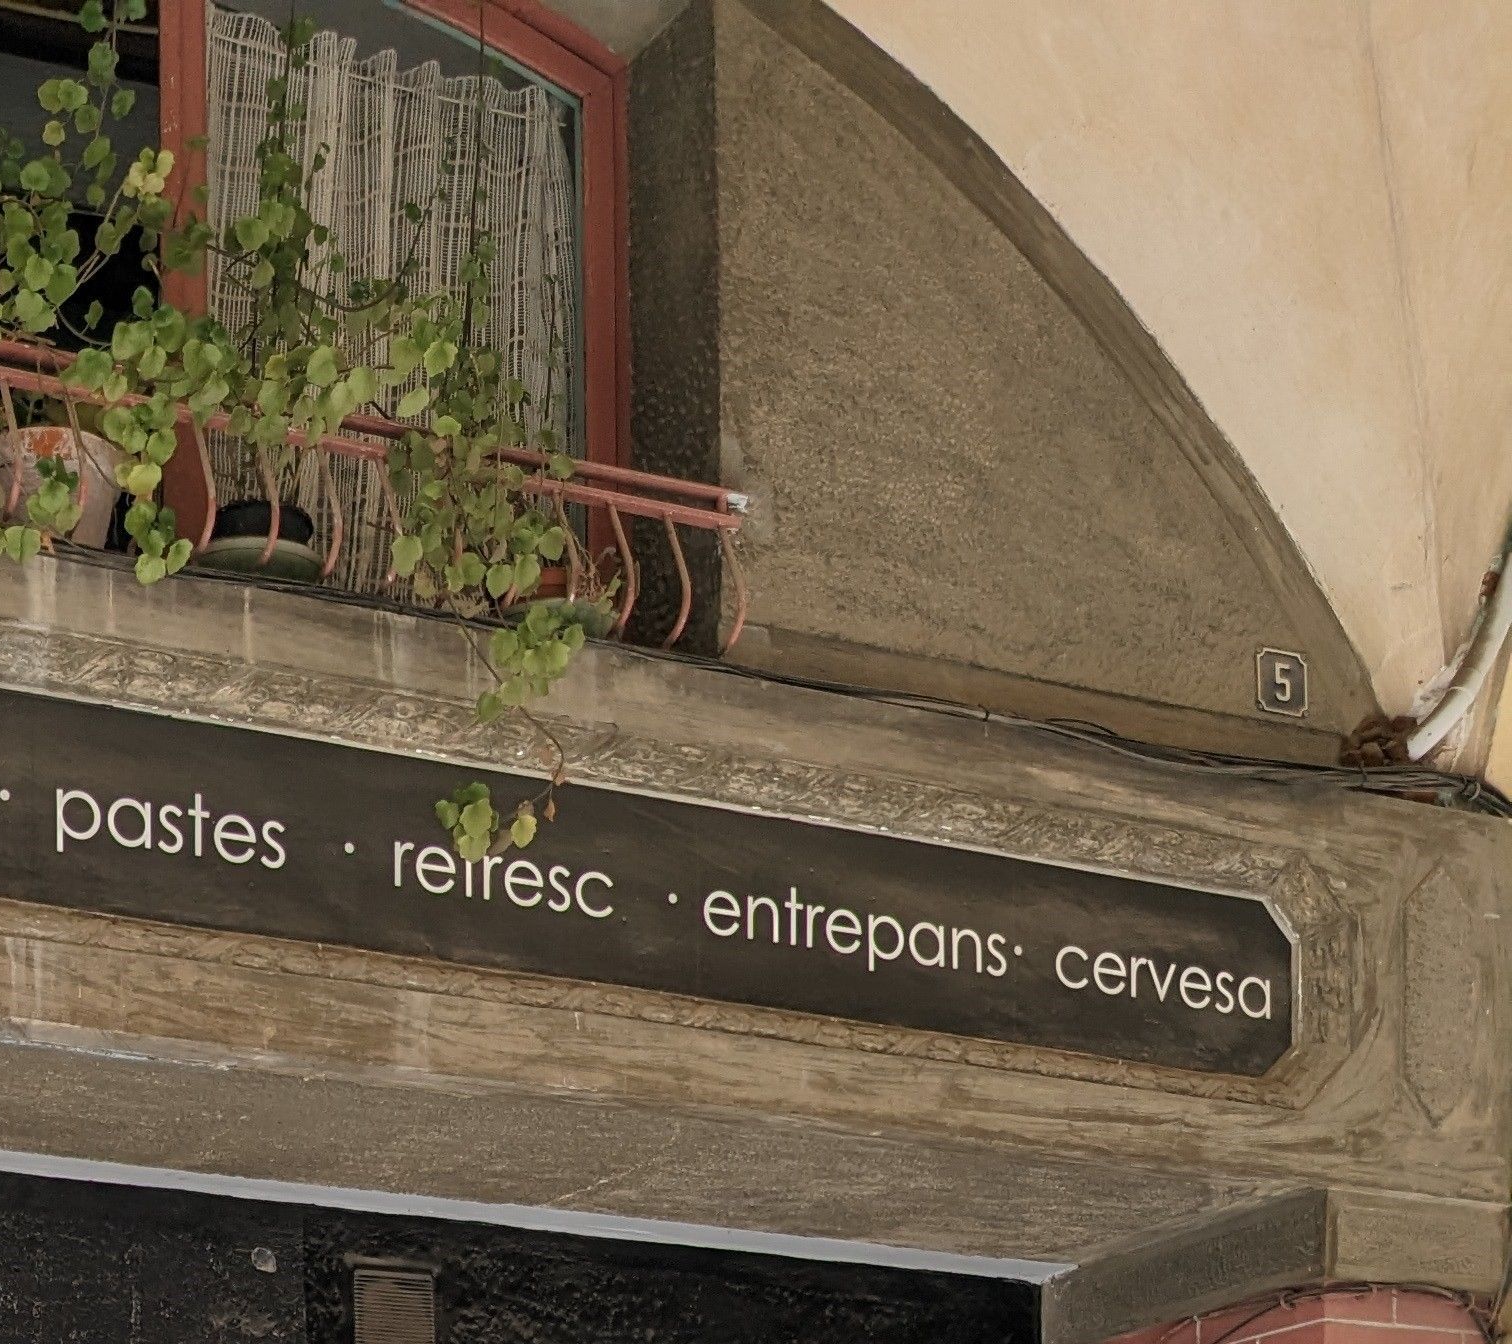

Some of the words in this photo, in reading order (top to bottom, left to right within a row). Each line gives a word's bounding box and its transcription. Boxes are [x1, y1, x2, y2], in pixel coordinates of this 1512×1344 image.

[1274, 661, 1291, 702] 5
[55, 788, 286, 869] pastes
[703, 886, 1007, 977] entrepans
[1055, 945, 1272, 1020] cervesa
